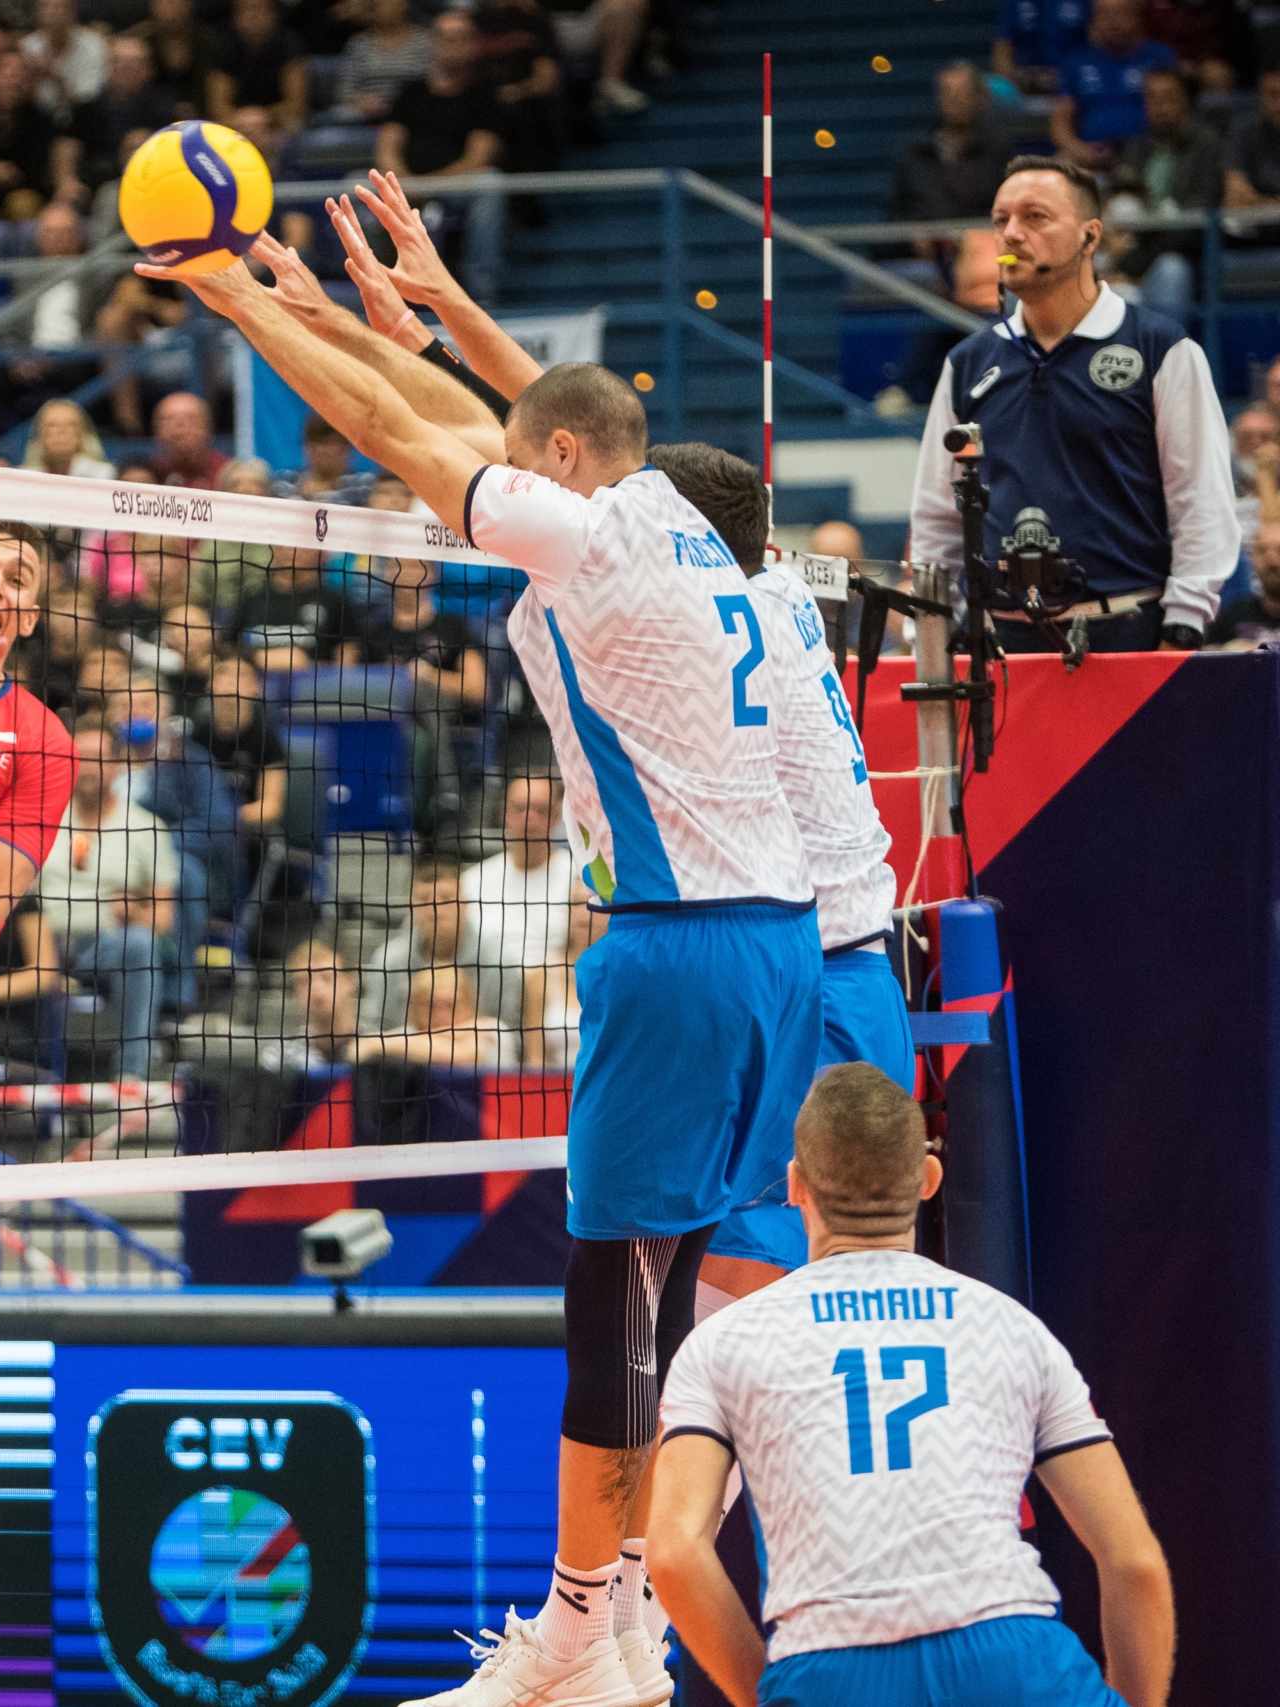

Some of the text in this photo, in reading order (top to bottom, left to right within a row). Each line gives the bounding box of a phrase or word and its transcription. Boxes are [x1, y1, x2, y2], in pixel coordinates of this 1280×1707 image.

[1101, 353, 1134, 367] FIVB
[112, 490, 213, 525] CEV EuroVolley 2021
[424, 524, 443, 547] CEV
[817, 565, 836, 586] CEV
[713, 594, 768, 727] 2
[811, 1286, 959, 1324] URNAUT
[831, 1345, 951, 1476] 17
[164, 1417, 294, 1471] CEV
